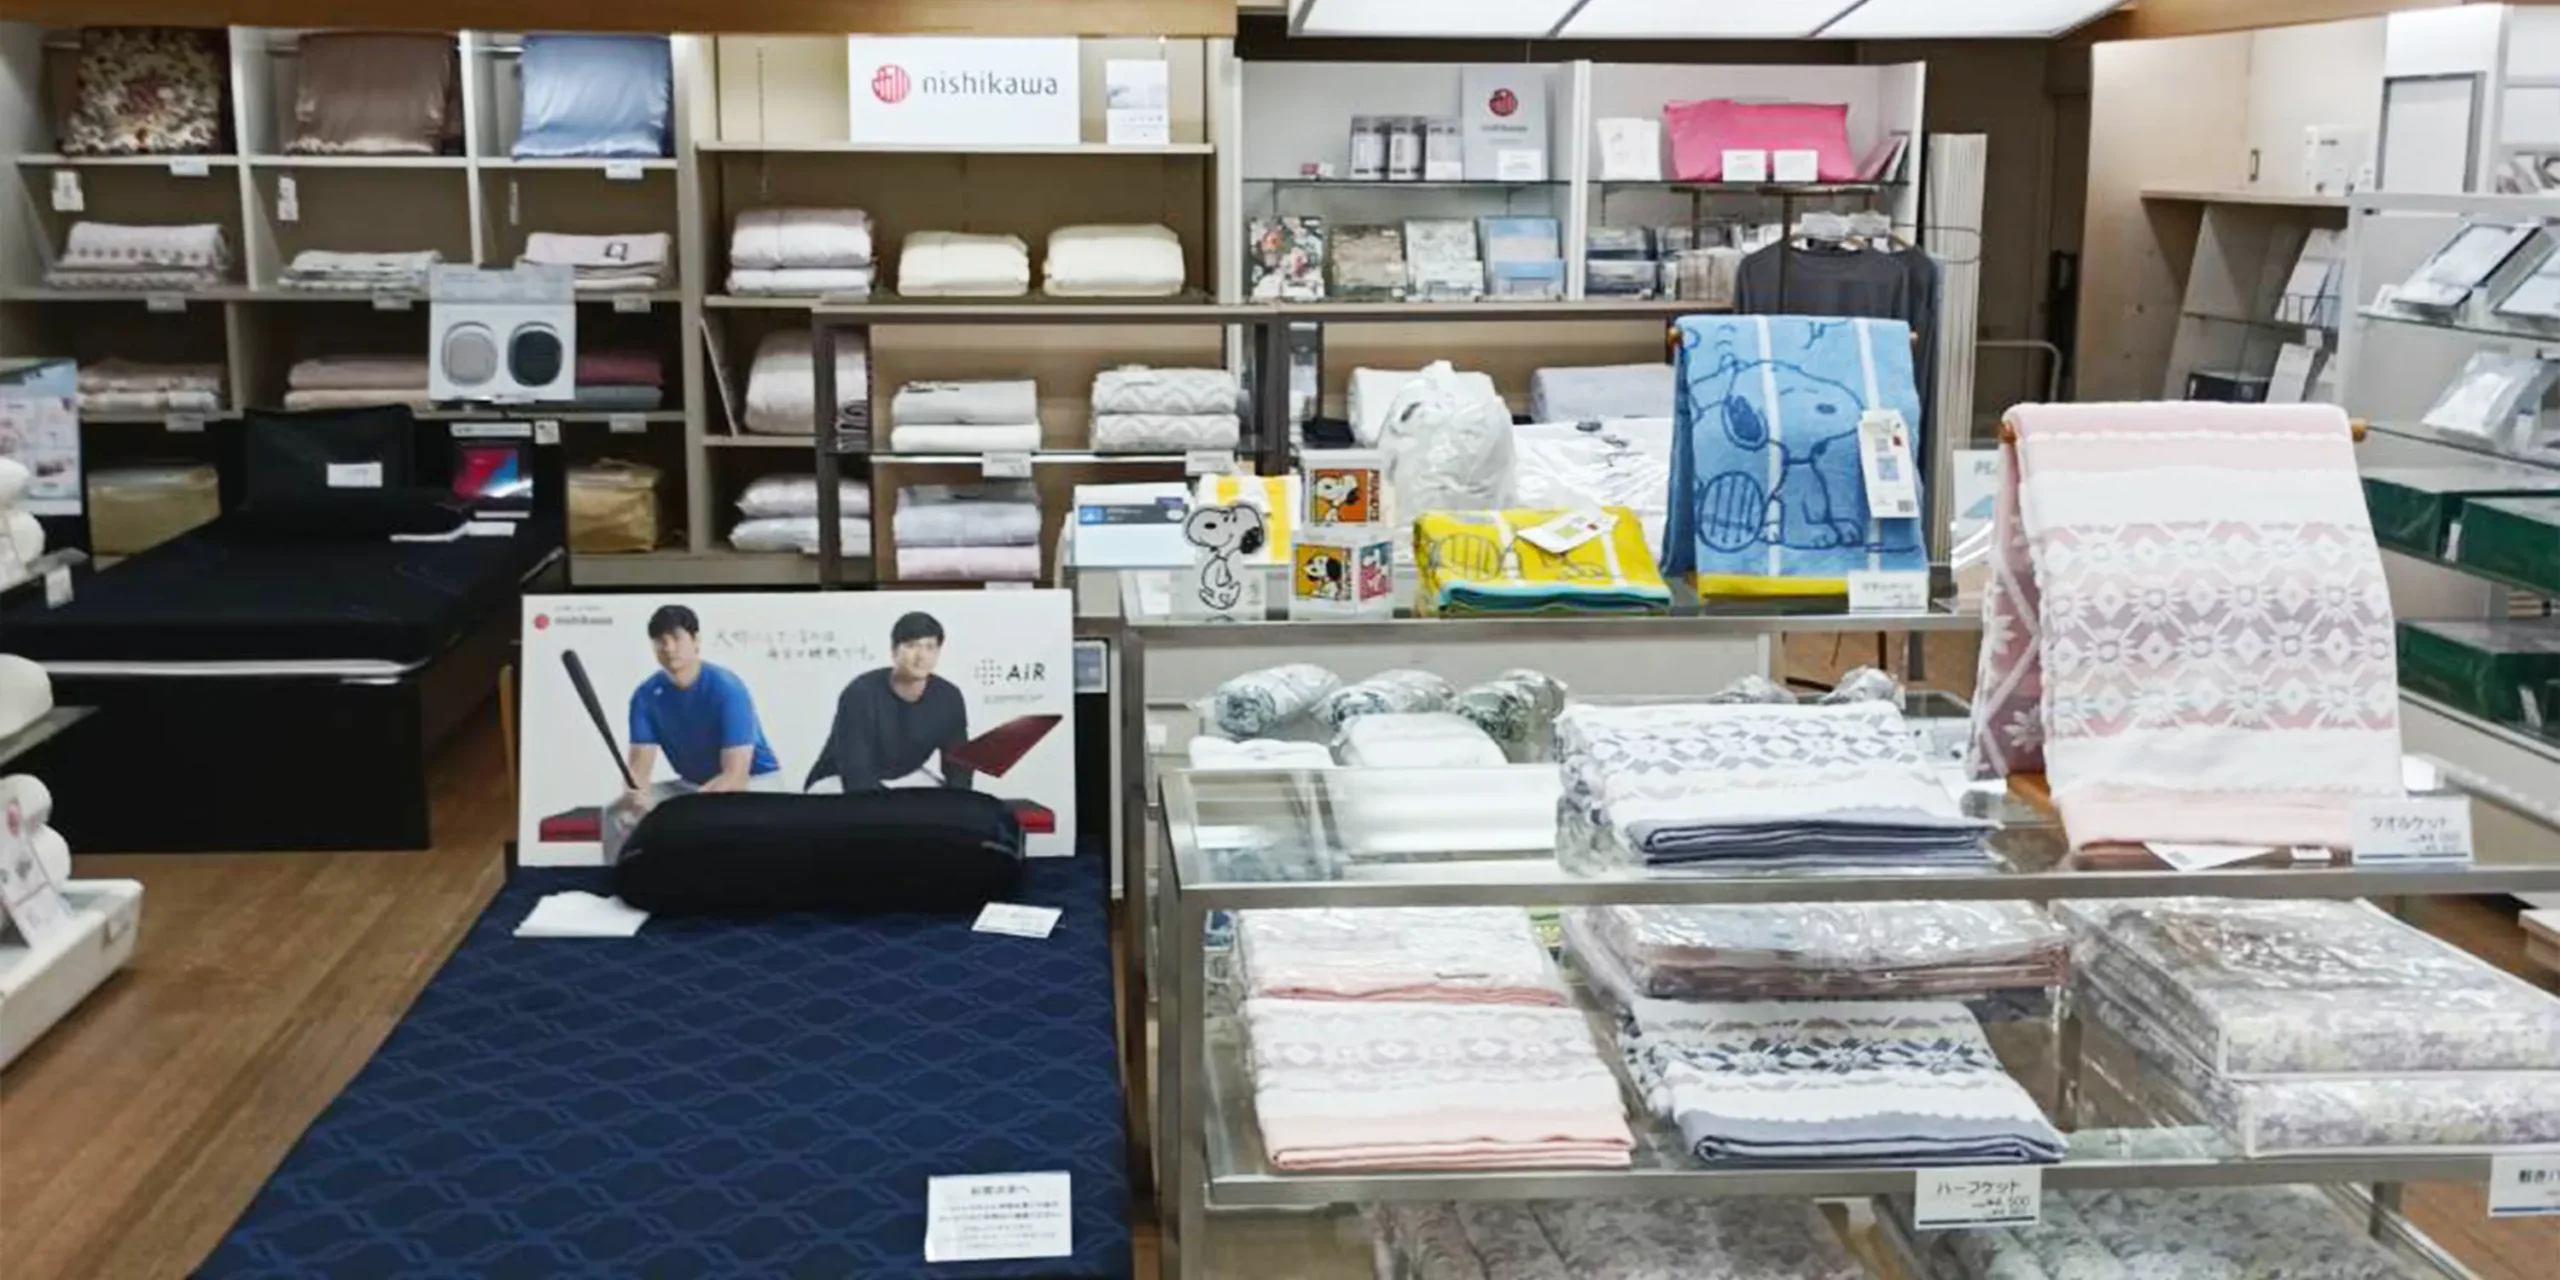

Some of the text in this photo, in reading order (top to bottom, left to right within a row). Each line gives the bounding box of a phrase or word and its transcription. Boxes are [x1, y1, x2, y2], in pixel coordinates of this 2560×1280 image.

[922, 70, 1059, 96] nishikawa
[2369, 815, 2448, 833] タオルケット
[1936, 1178, 2021, 1196] ハーフケット
